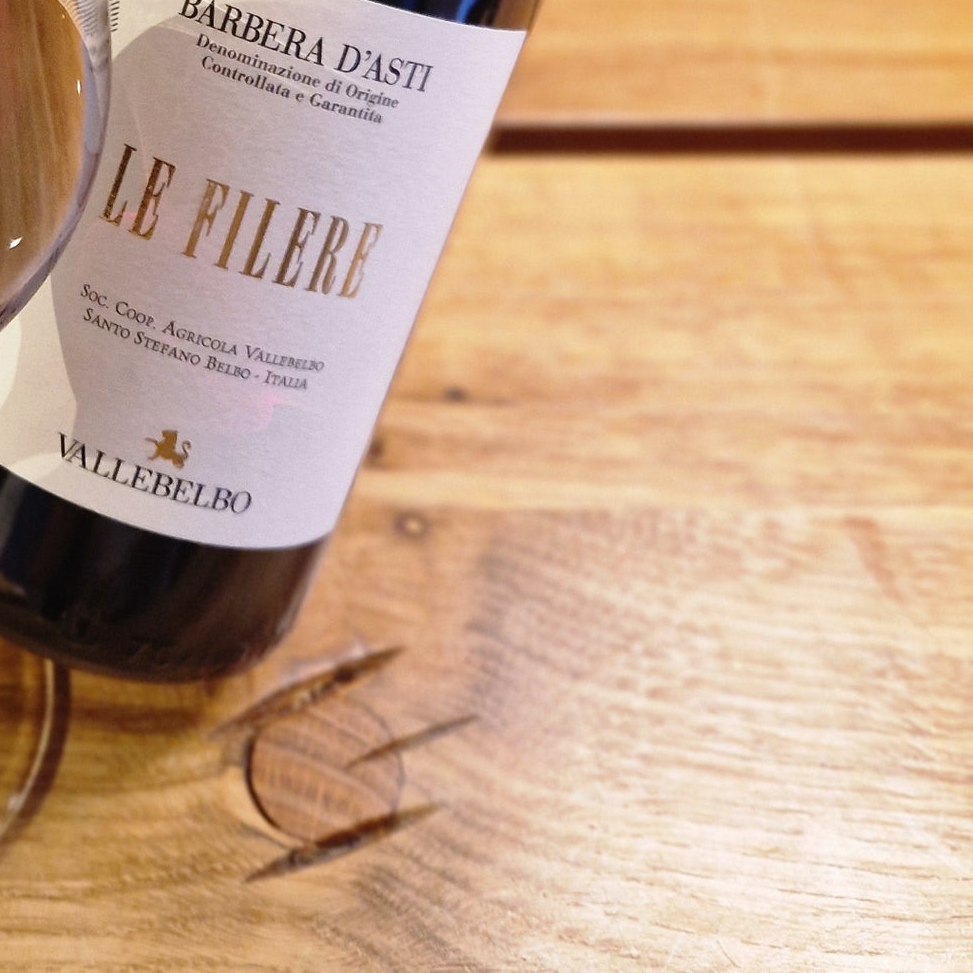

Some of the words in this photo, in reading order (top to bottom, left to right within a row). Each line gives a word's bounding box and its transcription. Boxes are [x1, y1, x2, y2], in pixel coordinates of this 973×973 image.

[196, 33, 321, 88] Denominazione
[325, 78, 342, 94] di
[345, 82, 400, 110] Origine
[201, 55, 290, 99] Controllata
[295, 92, 305, 103] e
[309, 94, 383, 124] Garantita
[334, 43, 434, 93] D'ASTI
[100, 143, 176, 241] LE
[180, 178, 384, 299] FILERE
[83, 307, 131, 339] SANTO
[133, 330, 201, 365] STEFANO
[58, 431, 252, 515] VALLEBELBO
